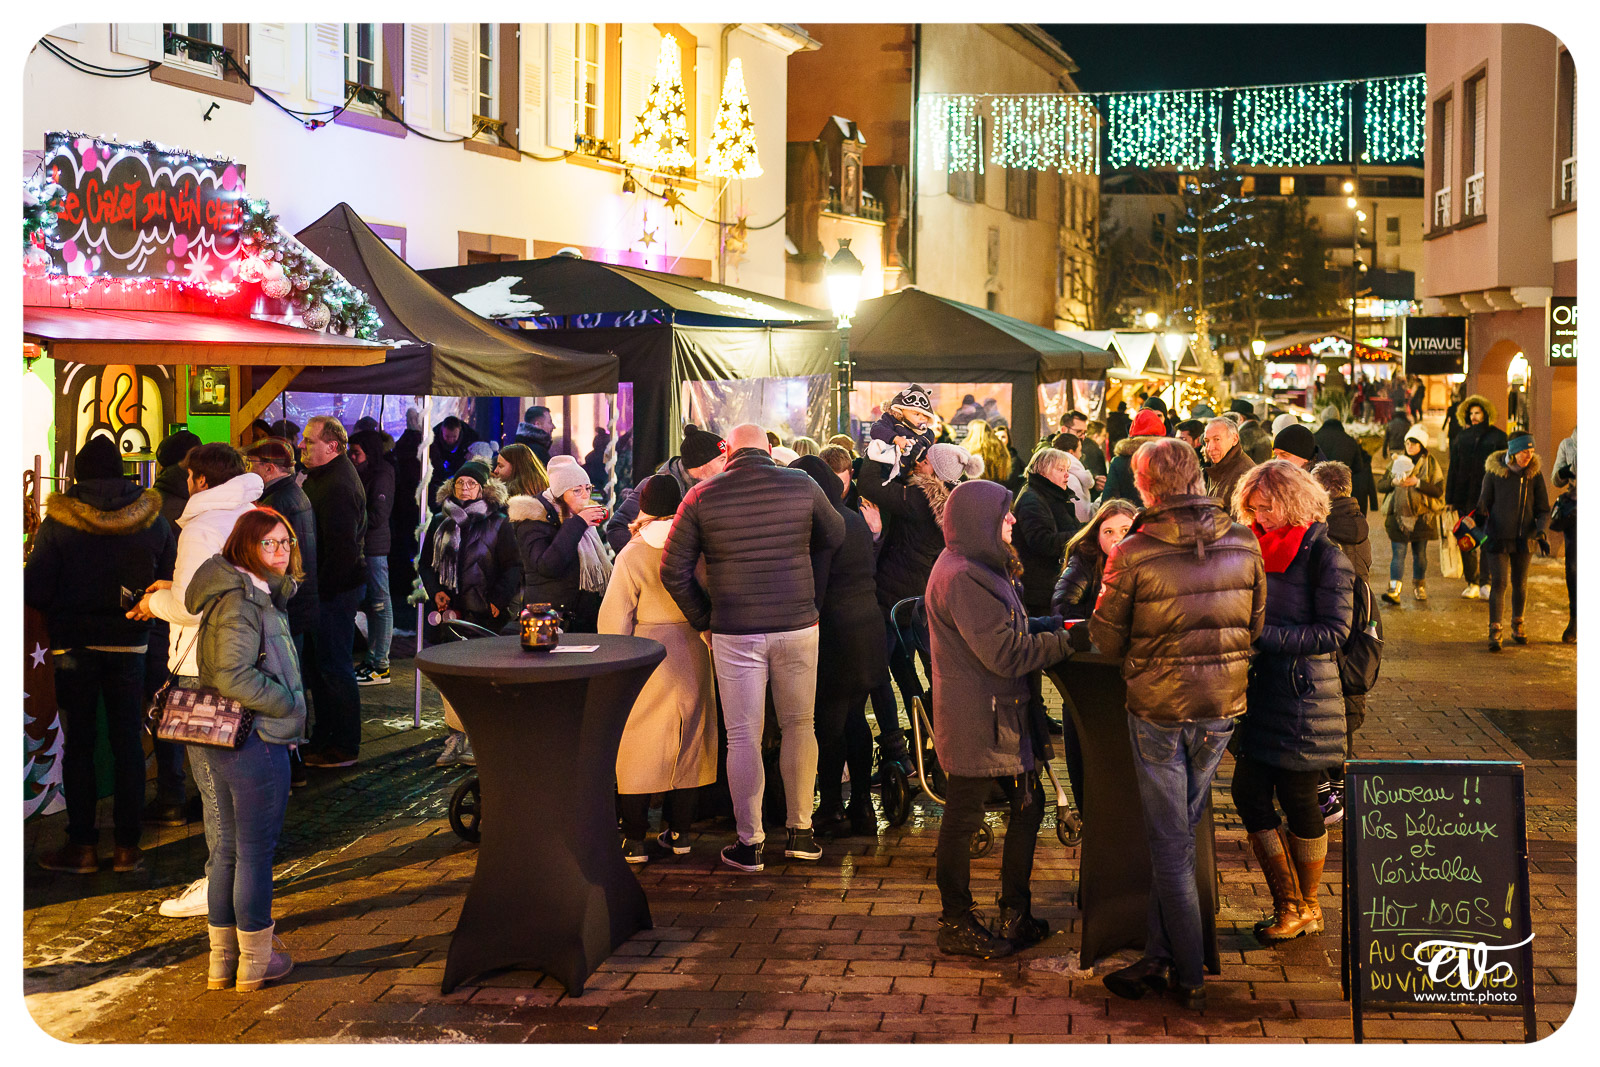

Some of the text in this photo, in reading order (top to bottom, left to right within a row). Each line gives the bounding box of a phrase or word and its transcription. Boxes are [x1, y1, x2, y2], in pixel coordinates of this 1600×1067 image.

[1409, 337, 1462, 350] VITAVUE
[1363, 776, 1454, 805] Nouveau
[1362, 808, 1498, 842] Nos Délicieux
[1410, 839, 1435, 858] et
[1372, 855, 1482, 885] Véritables
[1363, 896, 1418, 928] HOT
[1371, 970, 1392, 991] DU
